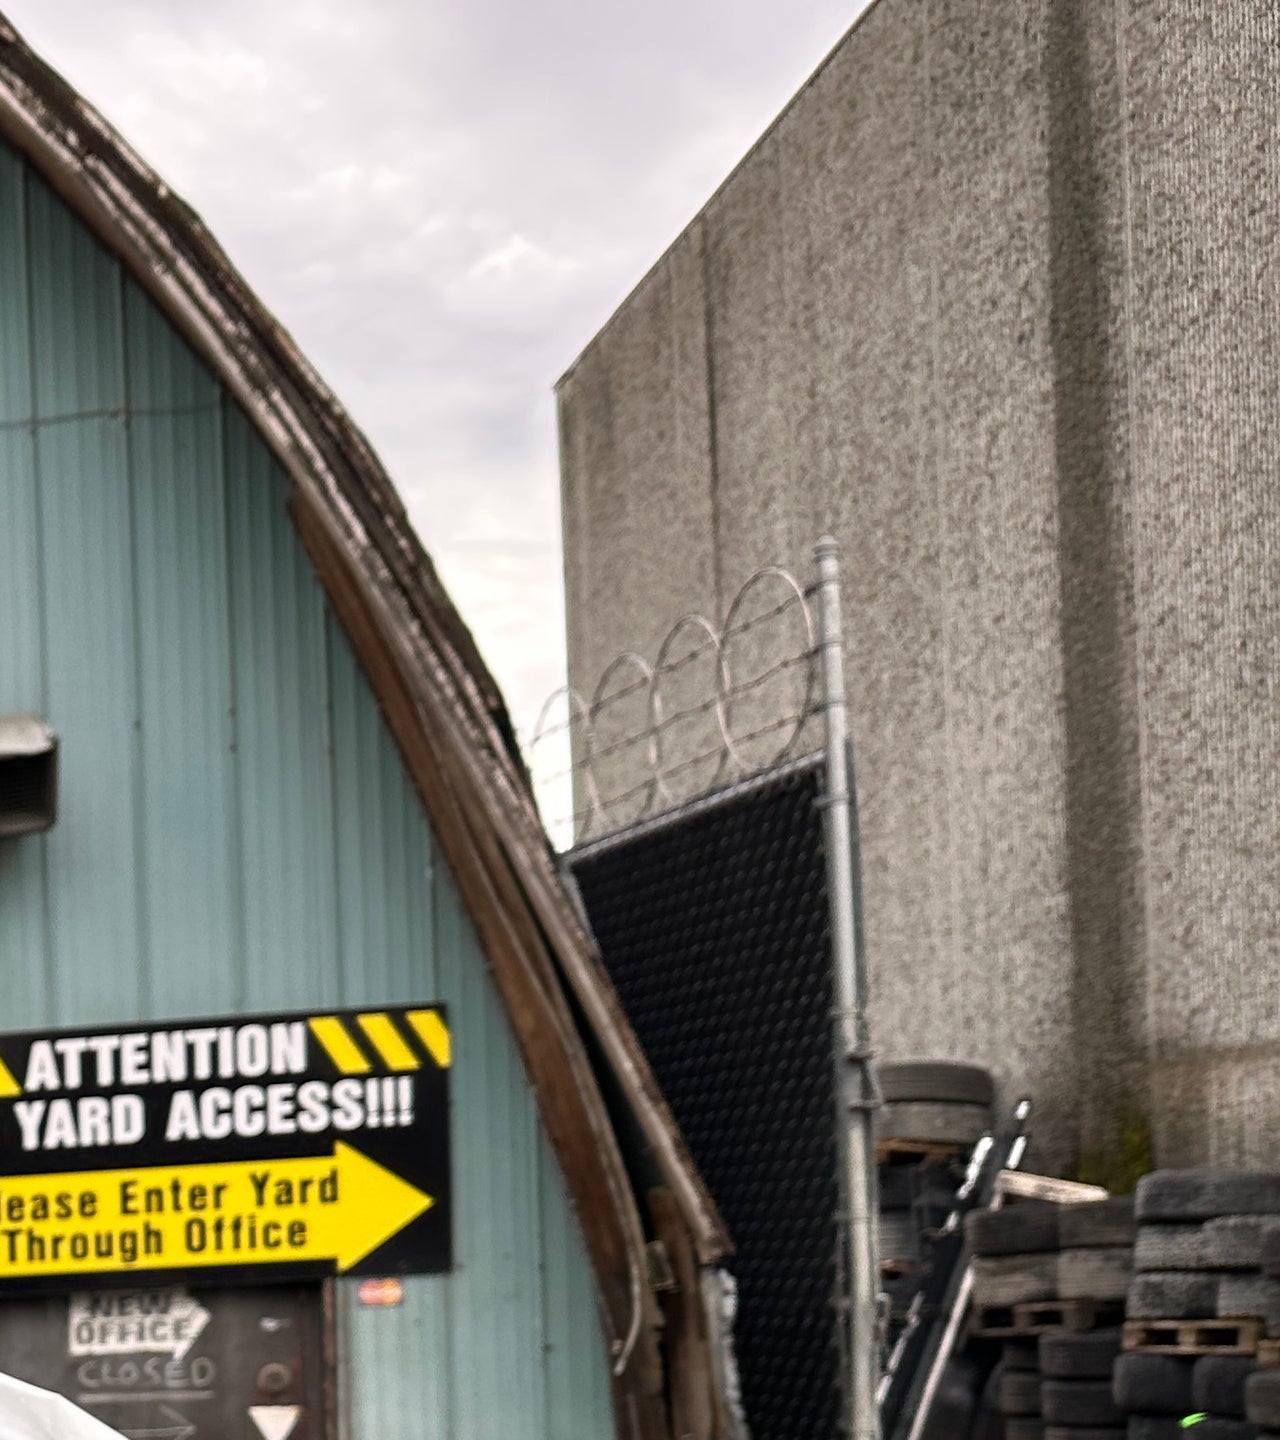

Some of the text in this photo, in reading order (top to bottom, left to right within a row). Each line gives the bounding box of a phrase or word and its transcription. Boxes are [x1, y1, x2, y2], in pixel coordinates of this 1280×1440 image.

[25, 1023, 308, 1092] ATTENTION
[13, 1095, 145, 1150] YARD
[166, 1077, 413, 1140] ACCESS!!!
[119, 1178, 228, 1216] Enter
[249, 1168, 339, 1207] Yard
[0, 1215, 308, 1264] Through Office
[76, 1317, 191, 1345] OFFICE
[77, 1356, 216, 1388] CLOSED
